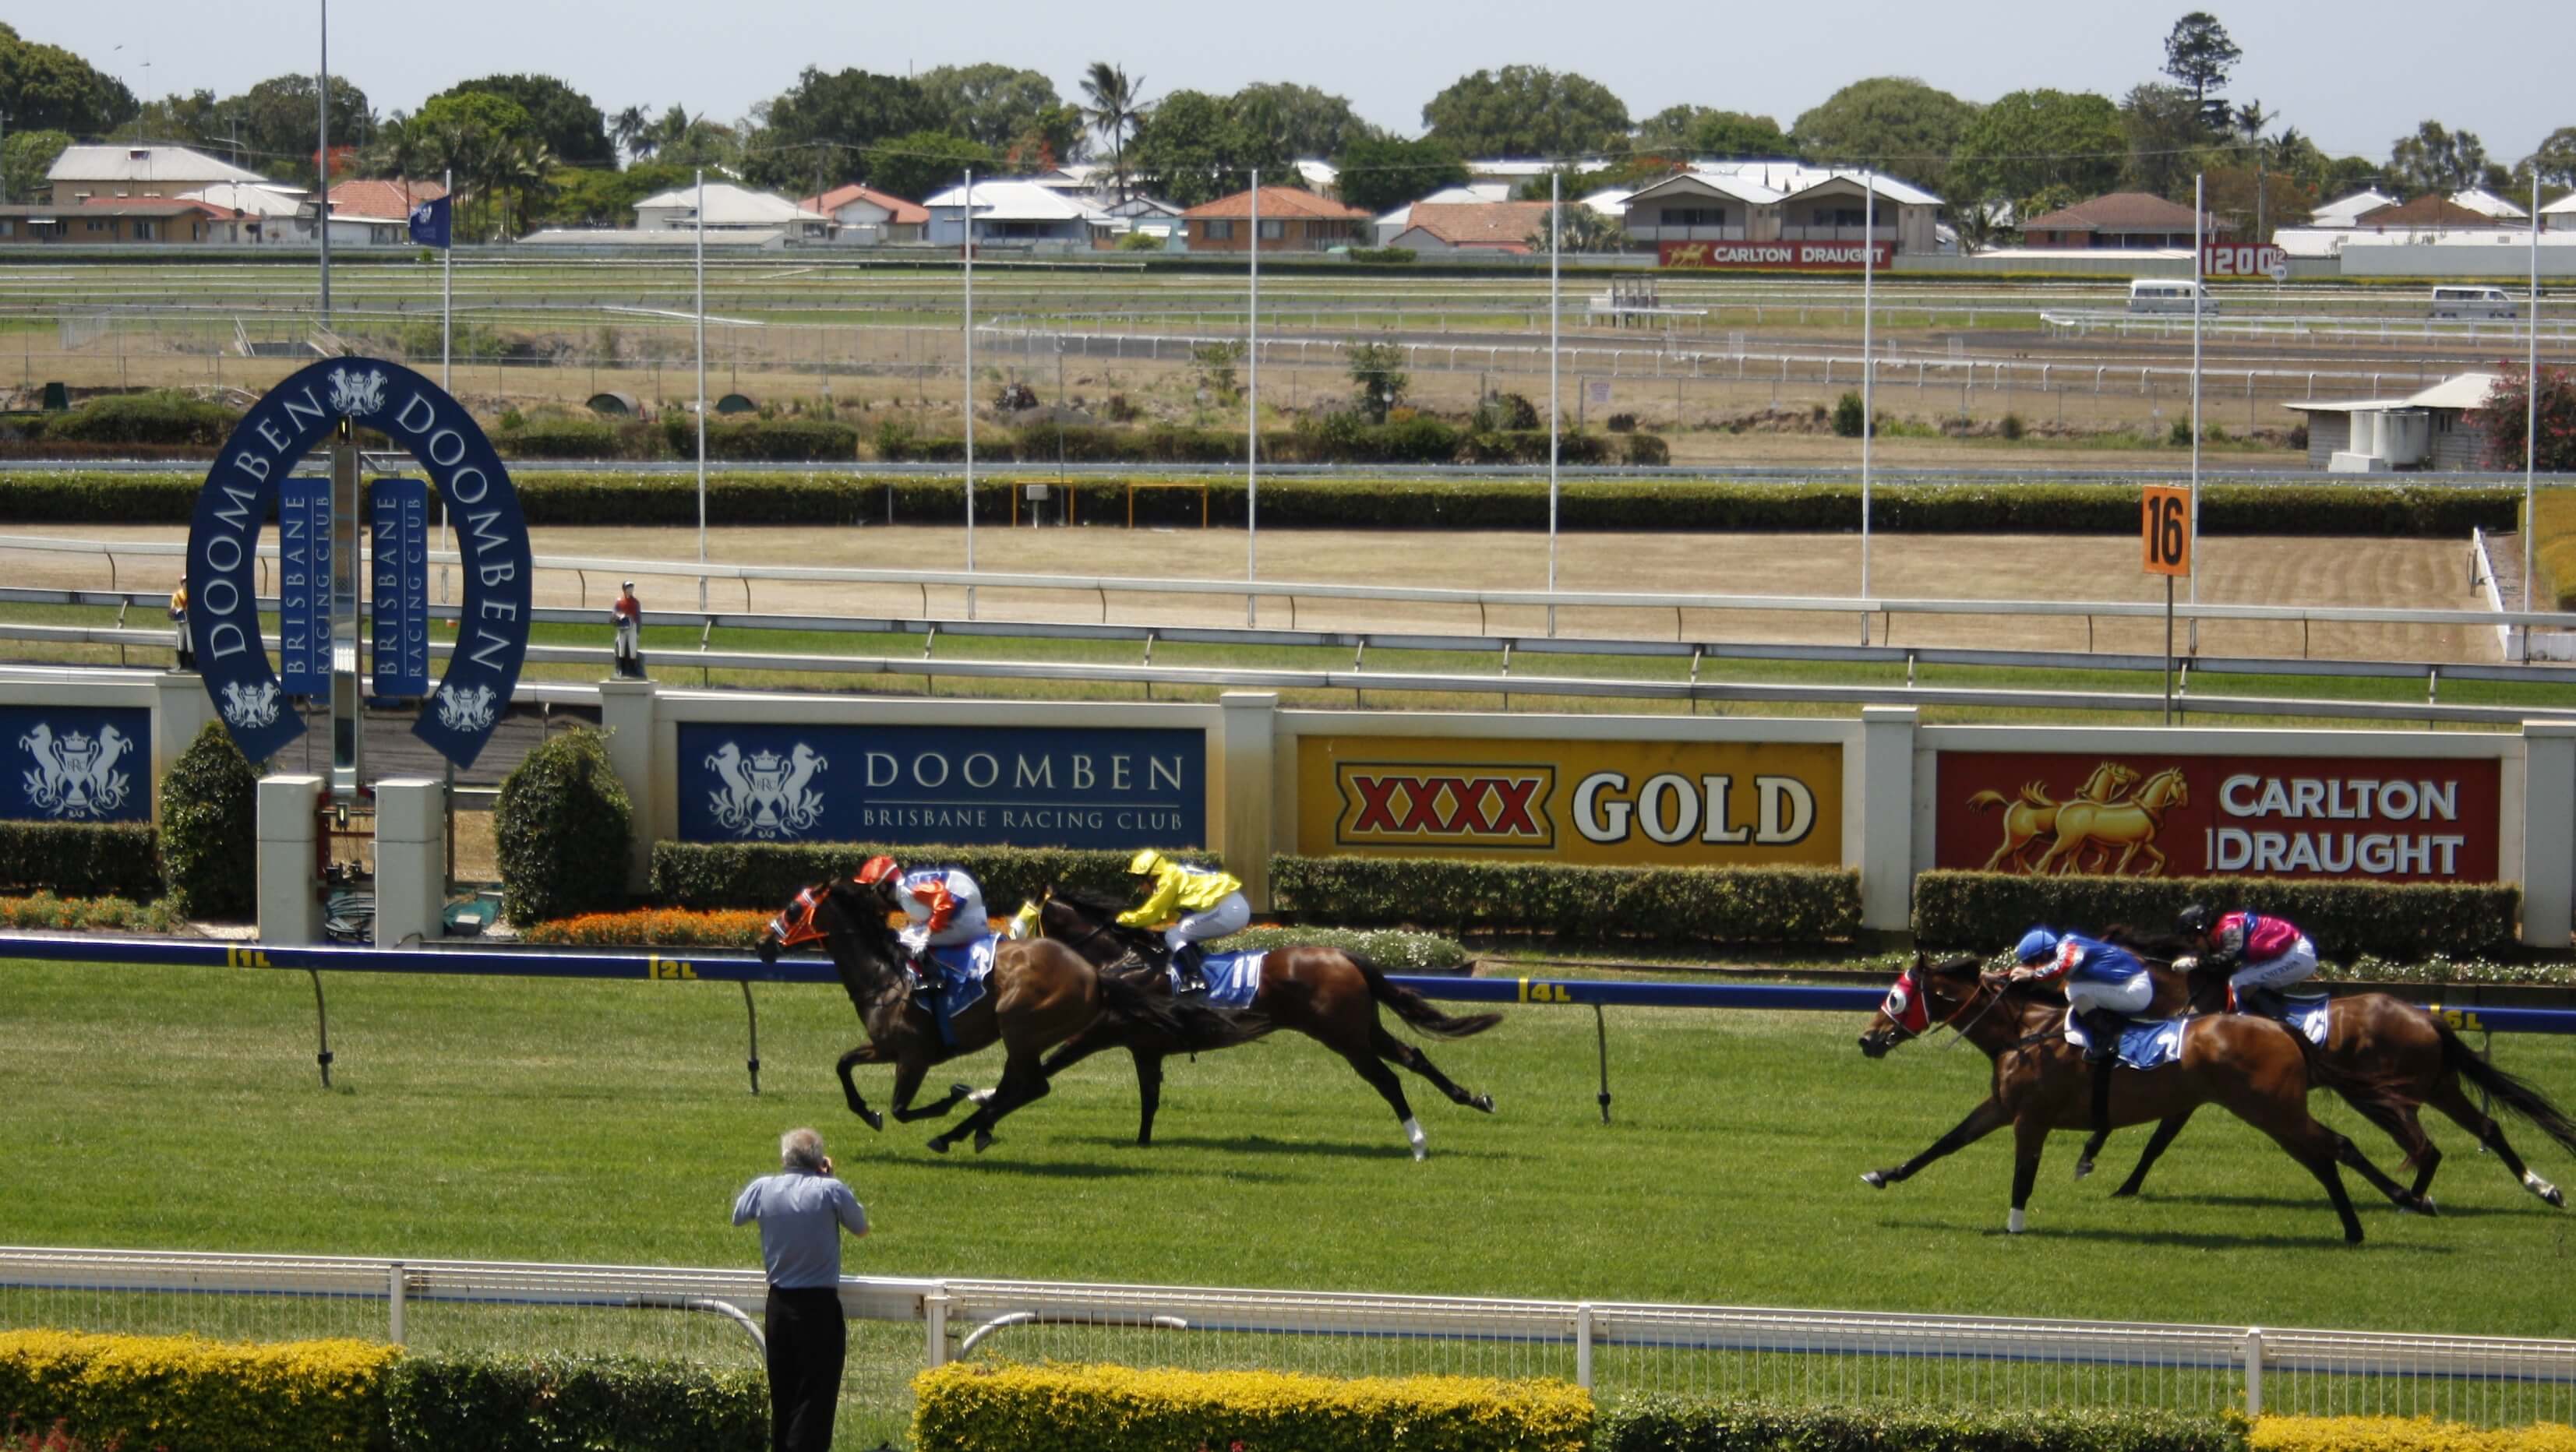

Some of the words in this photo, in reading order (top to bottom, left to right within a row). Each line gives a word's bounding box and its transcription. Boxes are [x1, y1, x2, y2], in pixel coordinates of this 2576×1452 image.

[1714, 247, 1791, 263] CARLTON
[2204, 248, 2271, 275] 1200
[203, 386, 327, 661] DOOMBEN
[316, 496, 330, 561] CLUB
[395, 393, 517, 672] DOOMBEN
[408, 499, 422, 563] CLUB
[2148, 495, 2183, 566] 16
[285, 497, 305, 674] BRISBANE
[377, 498, 397, 675] BRISBANE
[316, 574, 330, 675] RACING
[408, 577, 422, 677] RACING
[865, 752, 1183, 791] DOOMBEN
[2219, 774, 2458, 820] CARLTON
[864, 809, 986, 827] BRISBANE
[1003, 811, 1103, 829] RACING
[1117, 813, 1182, 830] CLUB
[1350, 775, 1542, 836] XXXX
[1572, 771, 1816, 845] GOLD
[2205, 828, 2465, 875] DRAUGHT
